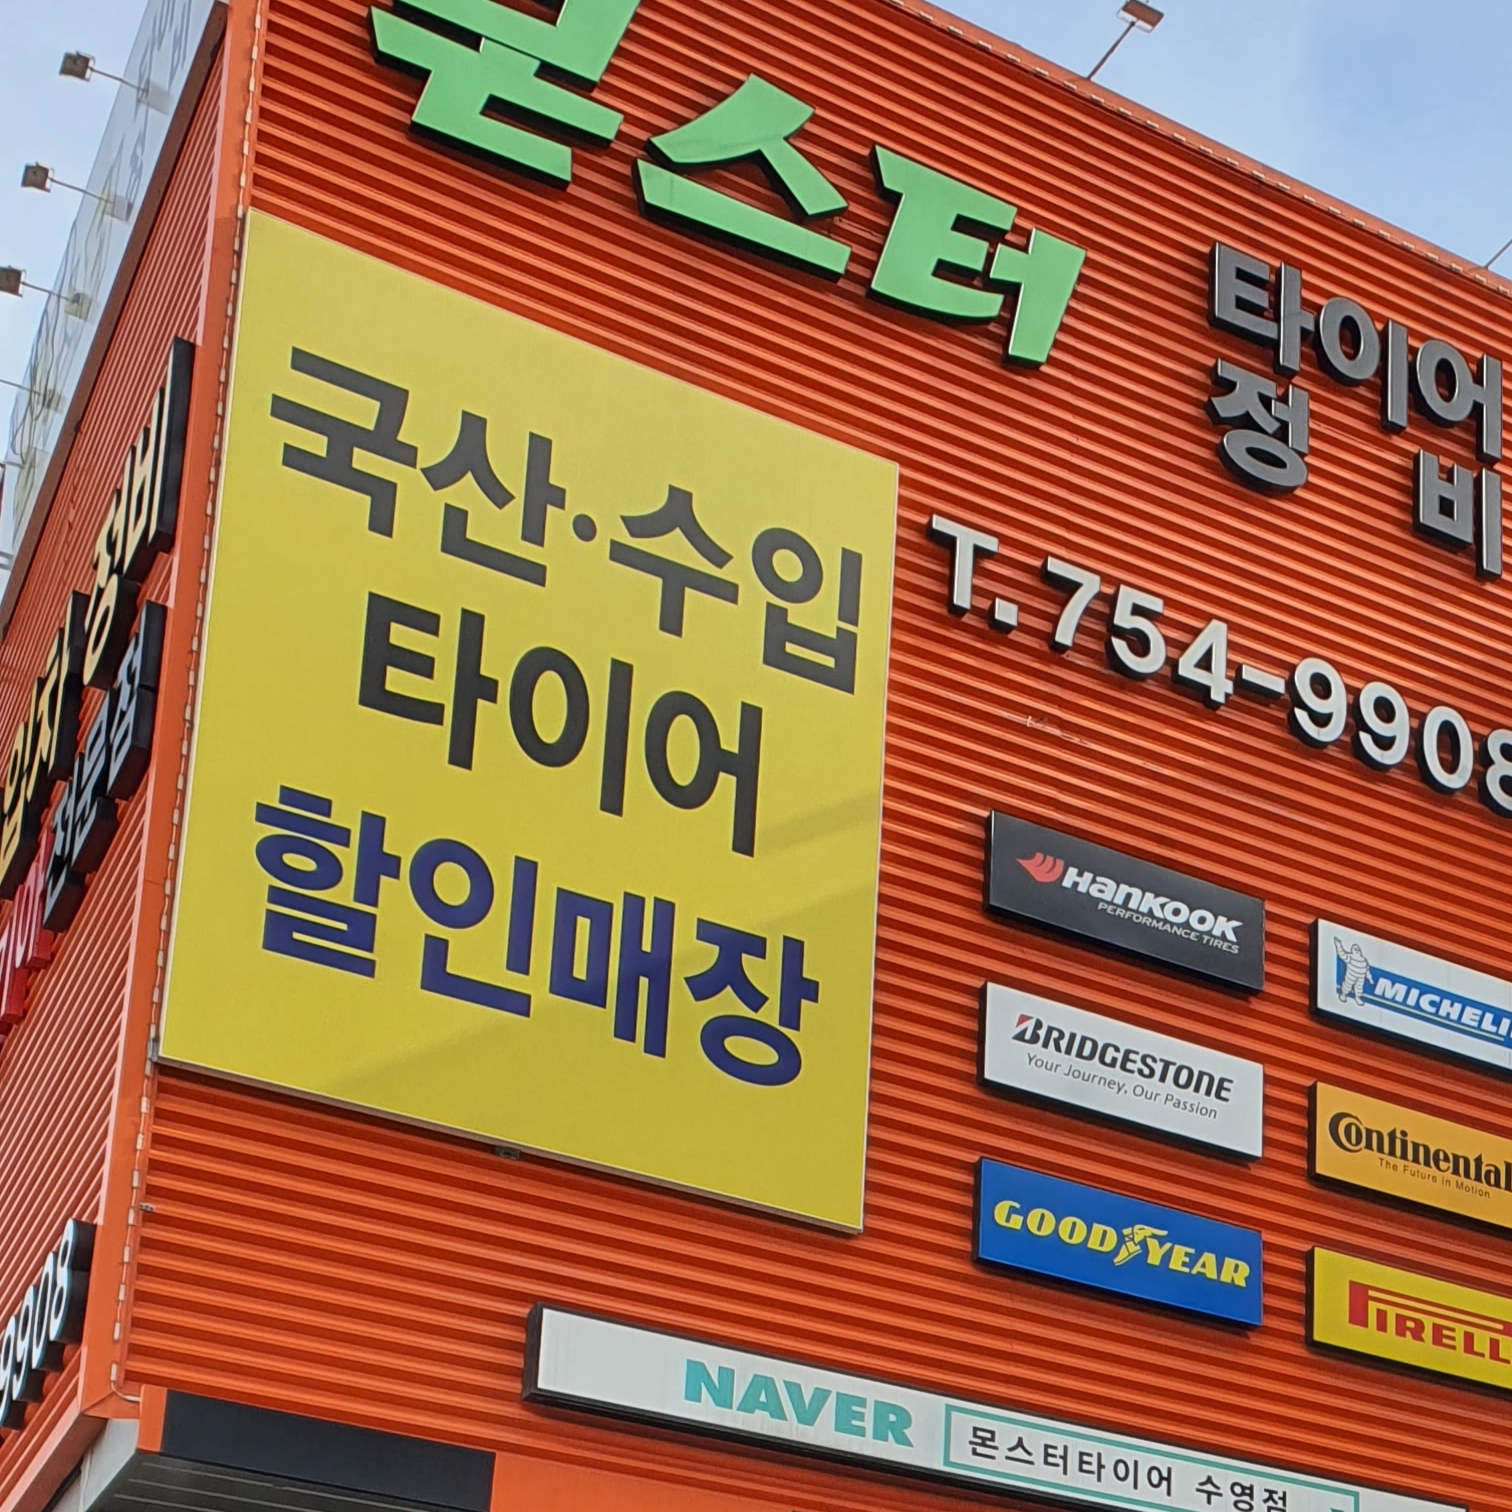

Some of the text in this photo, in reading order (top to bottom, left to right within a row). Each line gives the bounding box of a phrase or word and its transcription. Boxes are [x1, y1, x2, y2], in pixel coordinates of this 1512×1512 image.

[367, 0, 1088, 368] 몬스터
[1209, 241, 1503, 464] 타이어
[358, 591, 763, 858] 타이어
[254, 784, 820, 1087] 할인매장
[1097, 901, 1240, 955] PERFORMANCE TIRES
[1011, 1013, 1235, 1103] BRIDGESTONE
[1026, 1051, 1218, 1120] Your Journey, Our Passion
[1377, 1157, 1491, 1200] The Future in Motion
[683, 1357, 914, 1448] NAVER
[967, 1424, 1175, 1498] 몬스터타이어
